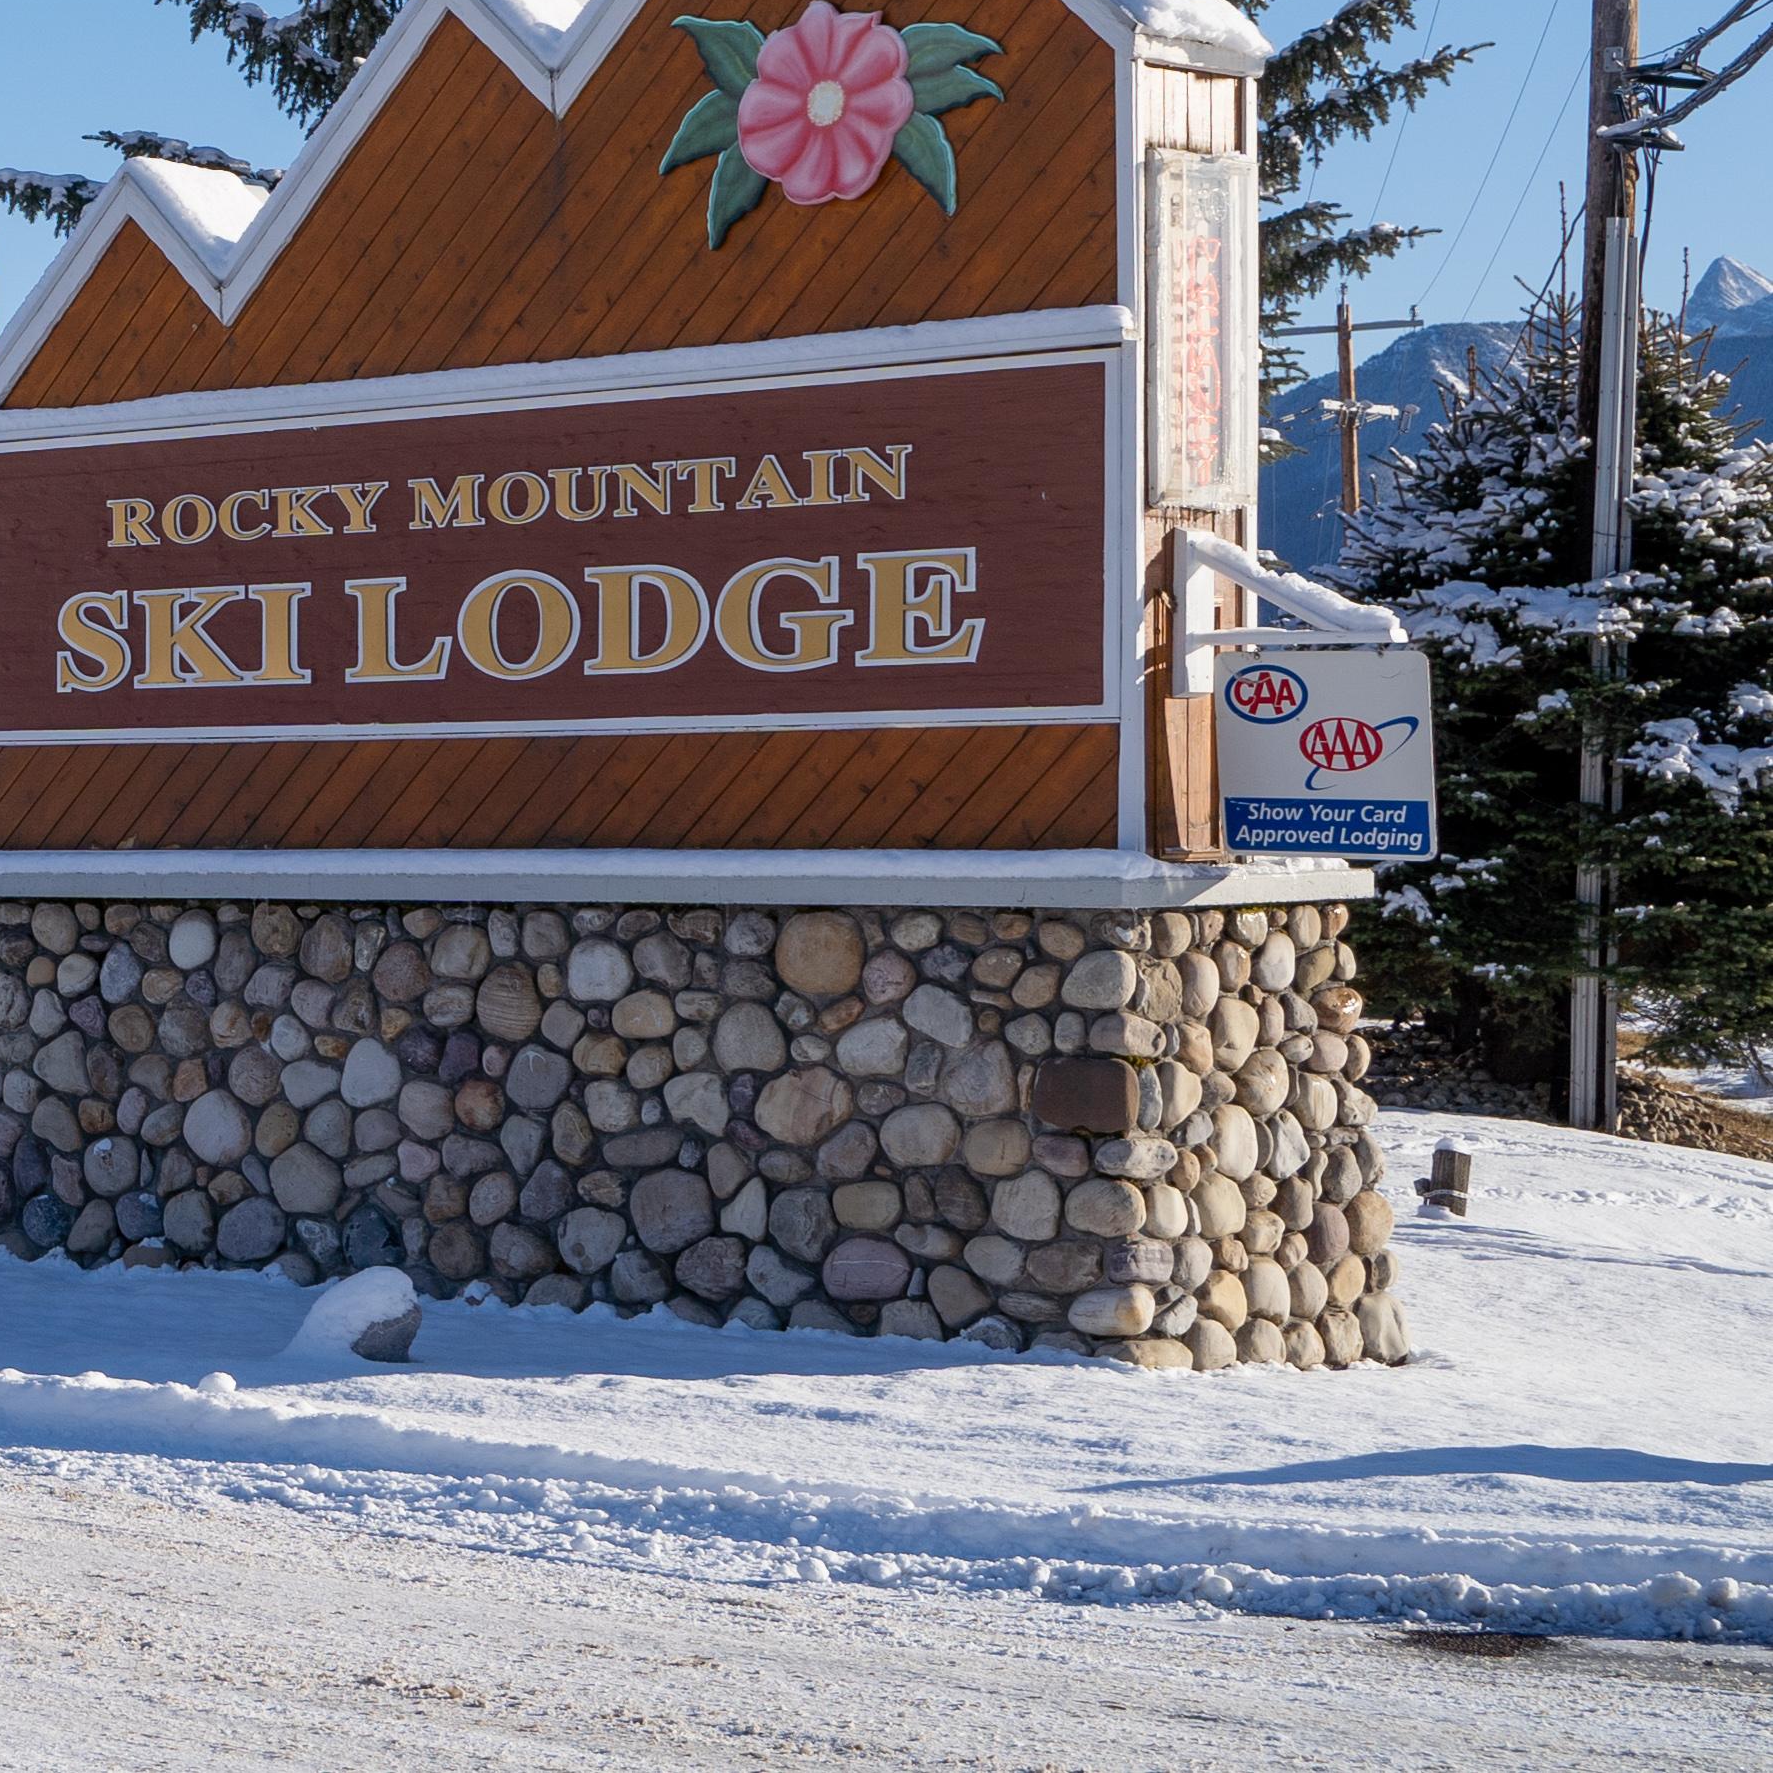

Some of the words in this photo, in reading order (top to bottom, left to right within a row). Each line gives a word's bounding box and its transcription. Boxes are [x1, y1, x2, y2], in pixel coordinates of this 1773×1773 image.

[106, 481, 390, 548] ROCKY
[407, 444, 913, 530] MOUNTAIN
[56, 581, 313, 693] SKI
[344, 546, 987, 684] LODGE
[1233, 672, 1297, 715] CAA
[1310, 718, 1375, 770] AAA
[1235, 825, 1334, 847] Approved
[1340, 827, 1423, 849] Lodging
[1248, 803, 1303, 821] Show
[1309, 804, 1355, 822] Your
[1360, 805, 1407, 824] Card
